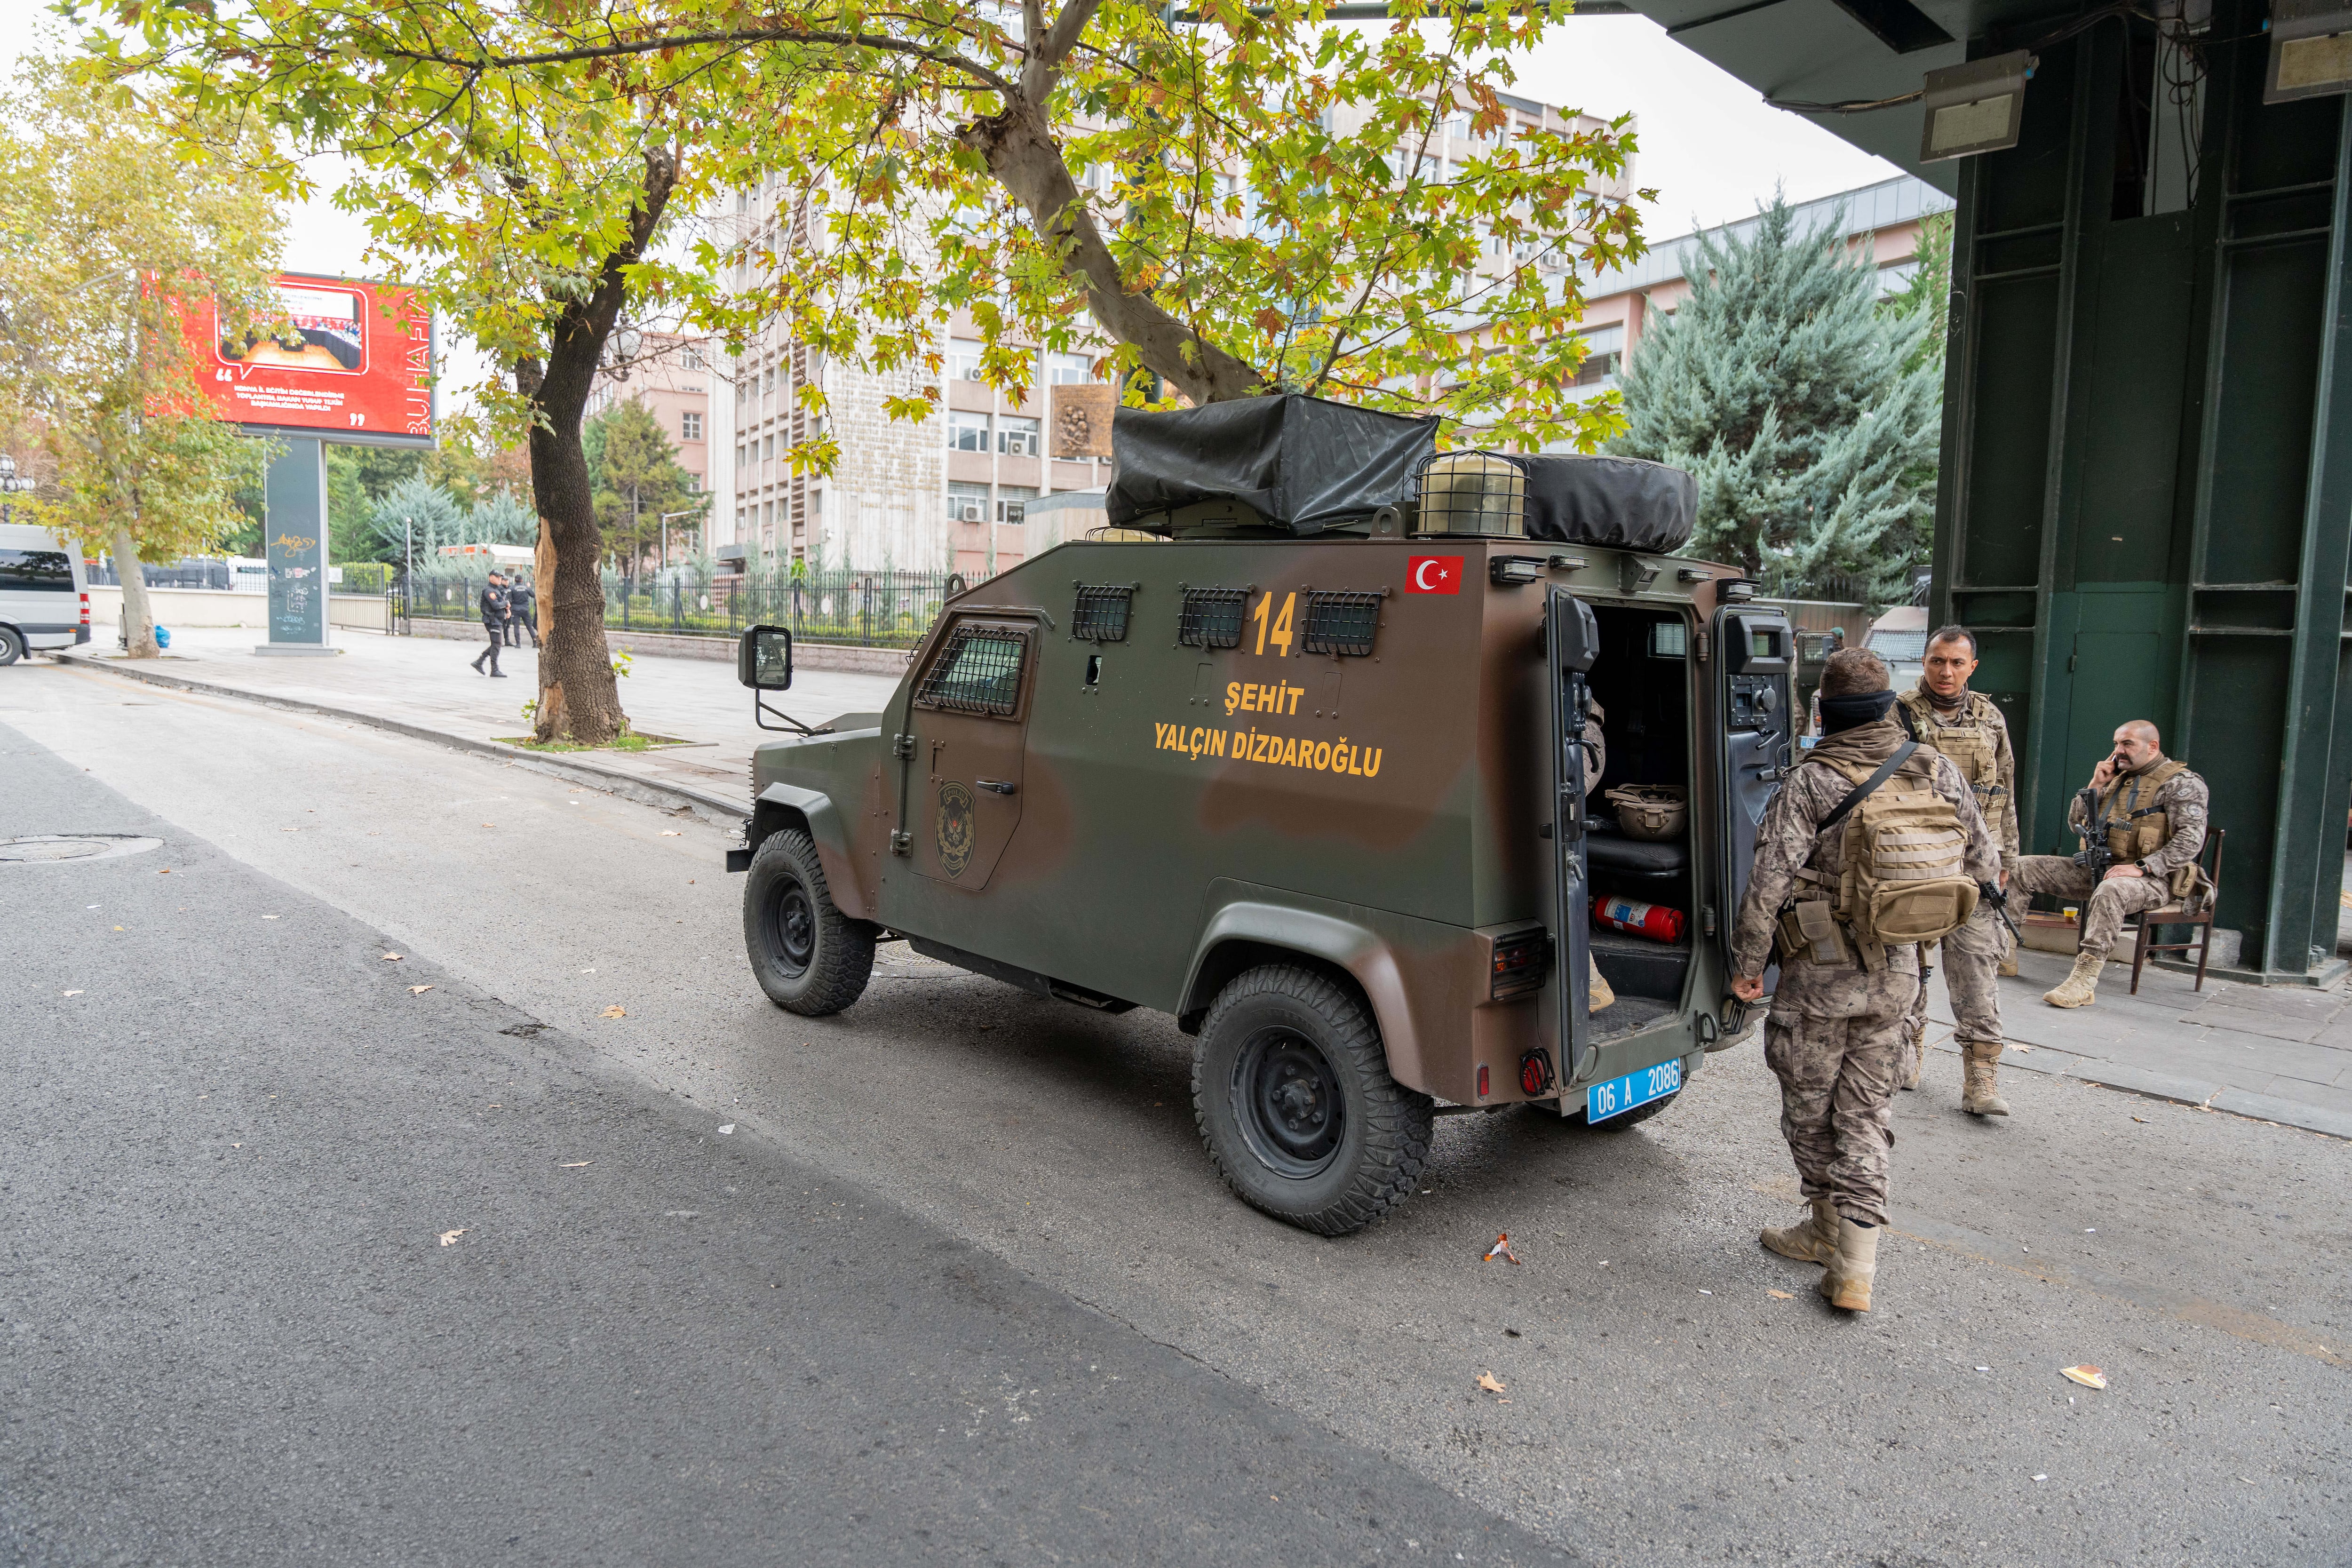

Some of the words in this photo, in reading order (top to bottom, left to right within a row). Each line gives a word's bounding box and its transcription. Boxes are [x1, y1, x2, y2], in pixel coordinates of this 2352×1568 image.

[1254, 591, 1296, 657] 14
[1224, 679, 1304, 716] ŞEHİT
[1154, 722, 1227, 761] YALÇIN
[1231, 726, 1383, 777] DİZDAROĞLU
[1598, 1083, 1615, 1114] 06
[1624, 1077, 1632, 1106] A
[1648, 1060, 1678, 1097] 2086
